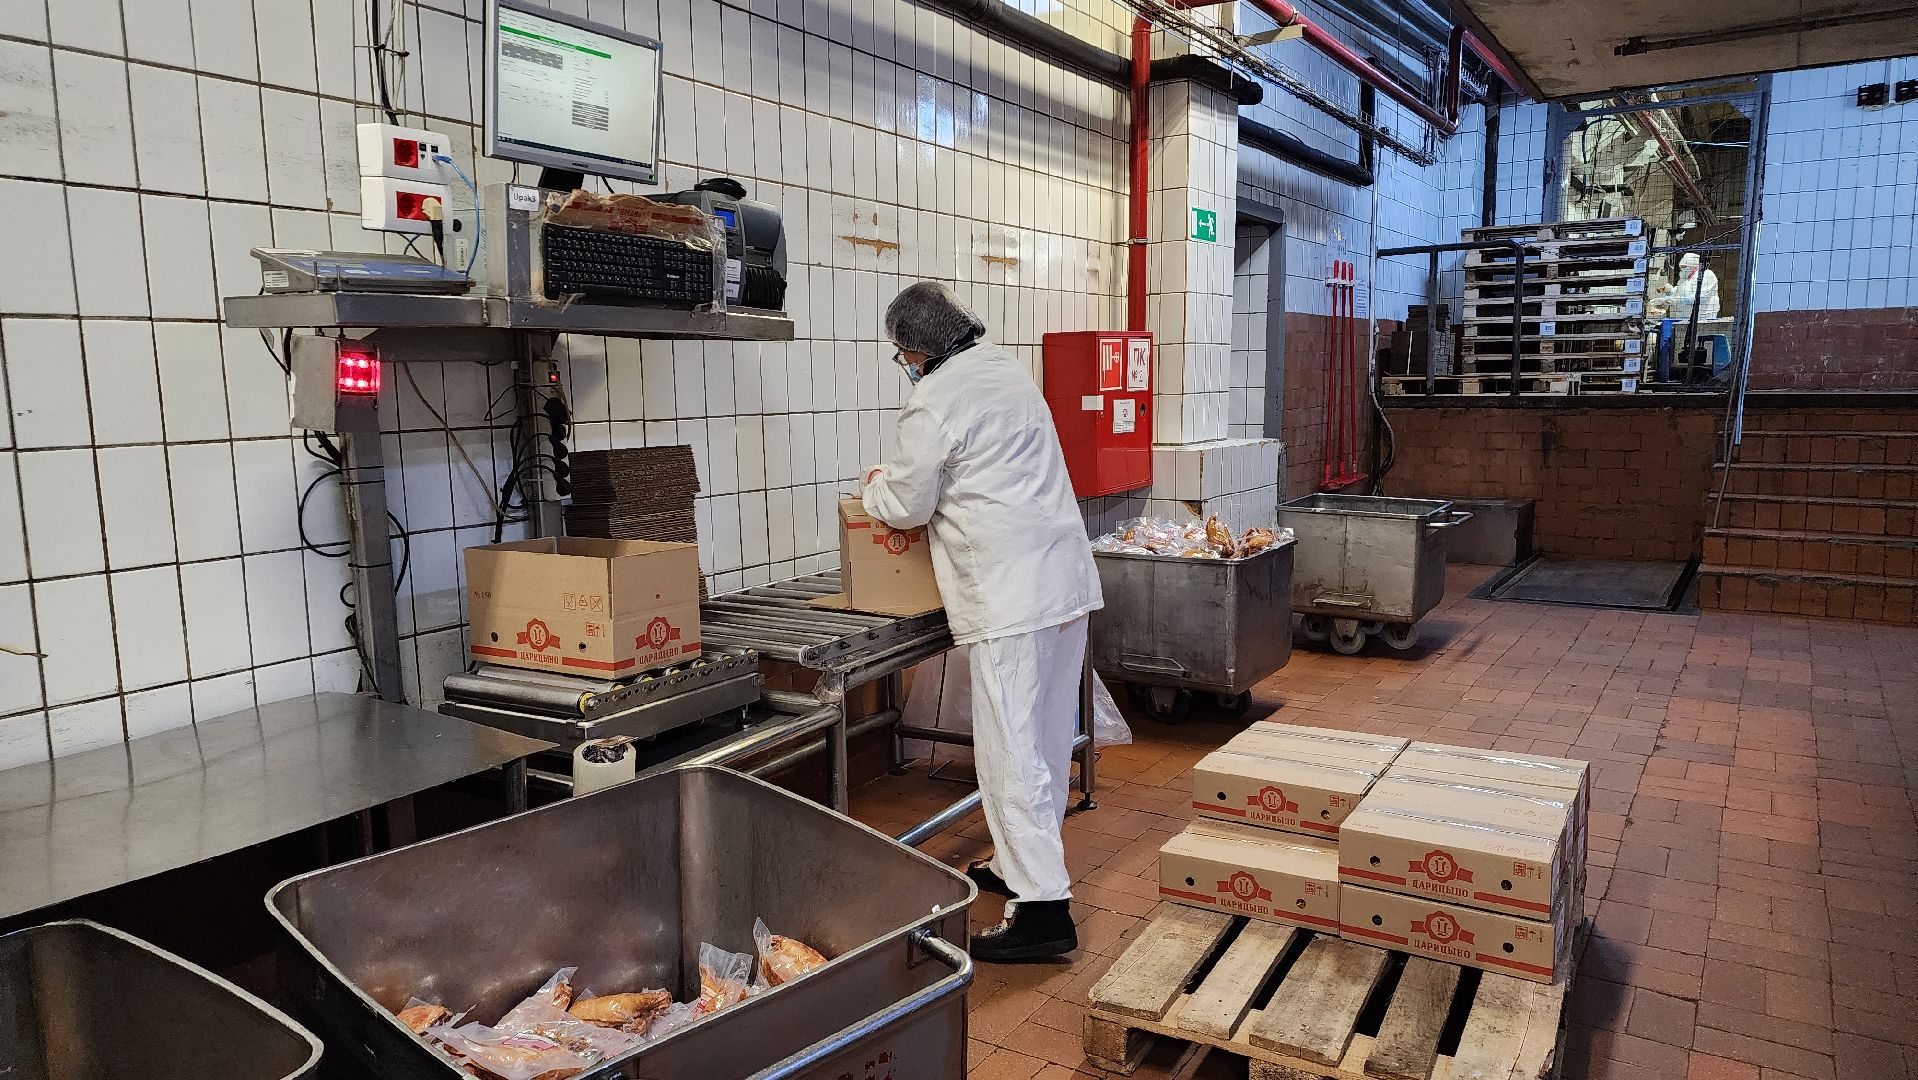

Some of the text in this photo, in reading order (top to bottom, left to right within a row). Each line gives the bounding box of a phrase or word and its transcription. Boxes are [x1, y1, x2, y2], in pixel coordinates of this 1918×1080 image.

[1133, 347, 1146, 367] ПК
[520, 651, 559, 665] ЦАРИЦЫНО
[639, 647, 679, 665] ЦАРИЦЫНО
[1250, 811, 1296, 826] ЦАРИЦЫНО
[1411, 879, 1469, 898] ЦАРИЦЫНО
[1220, 898, 1269, 915] ЦАРИЦЫНО
[1413, 939, 1471, 959] ЦАРИЦЫНО
